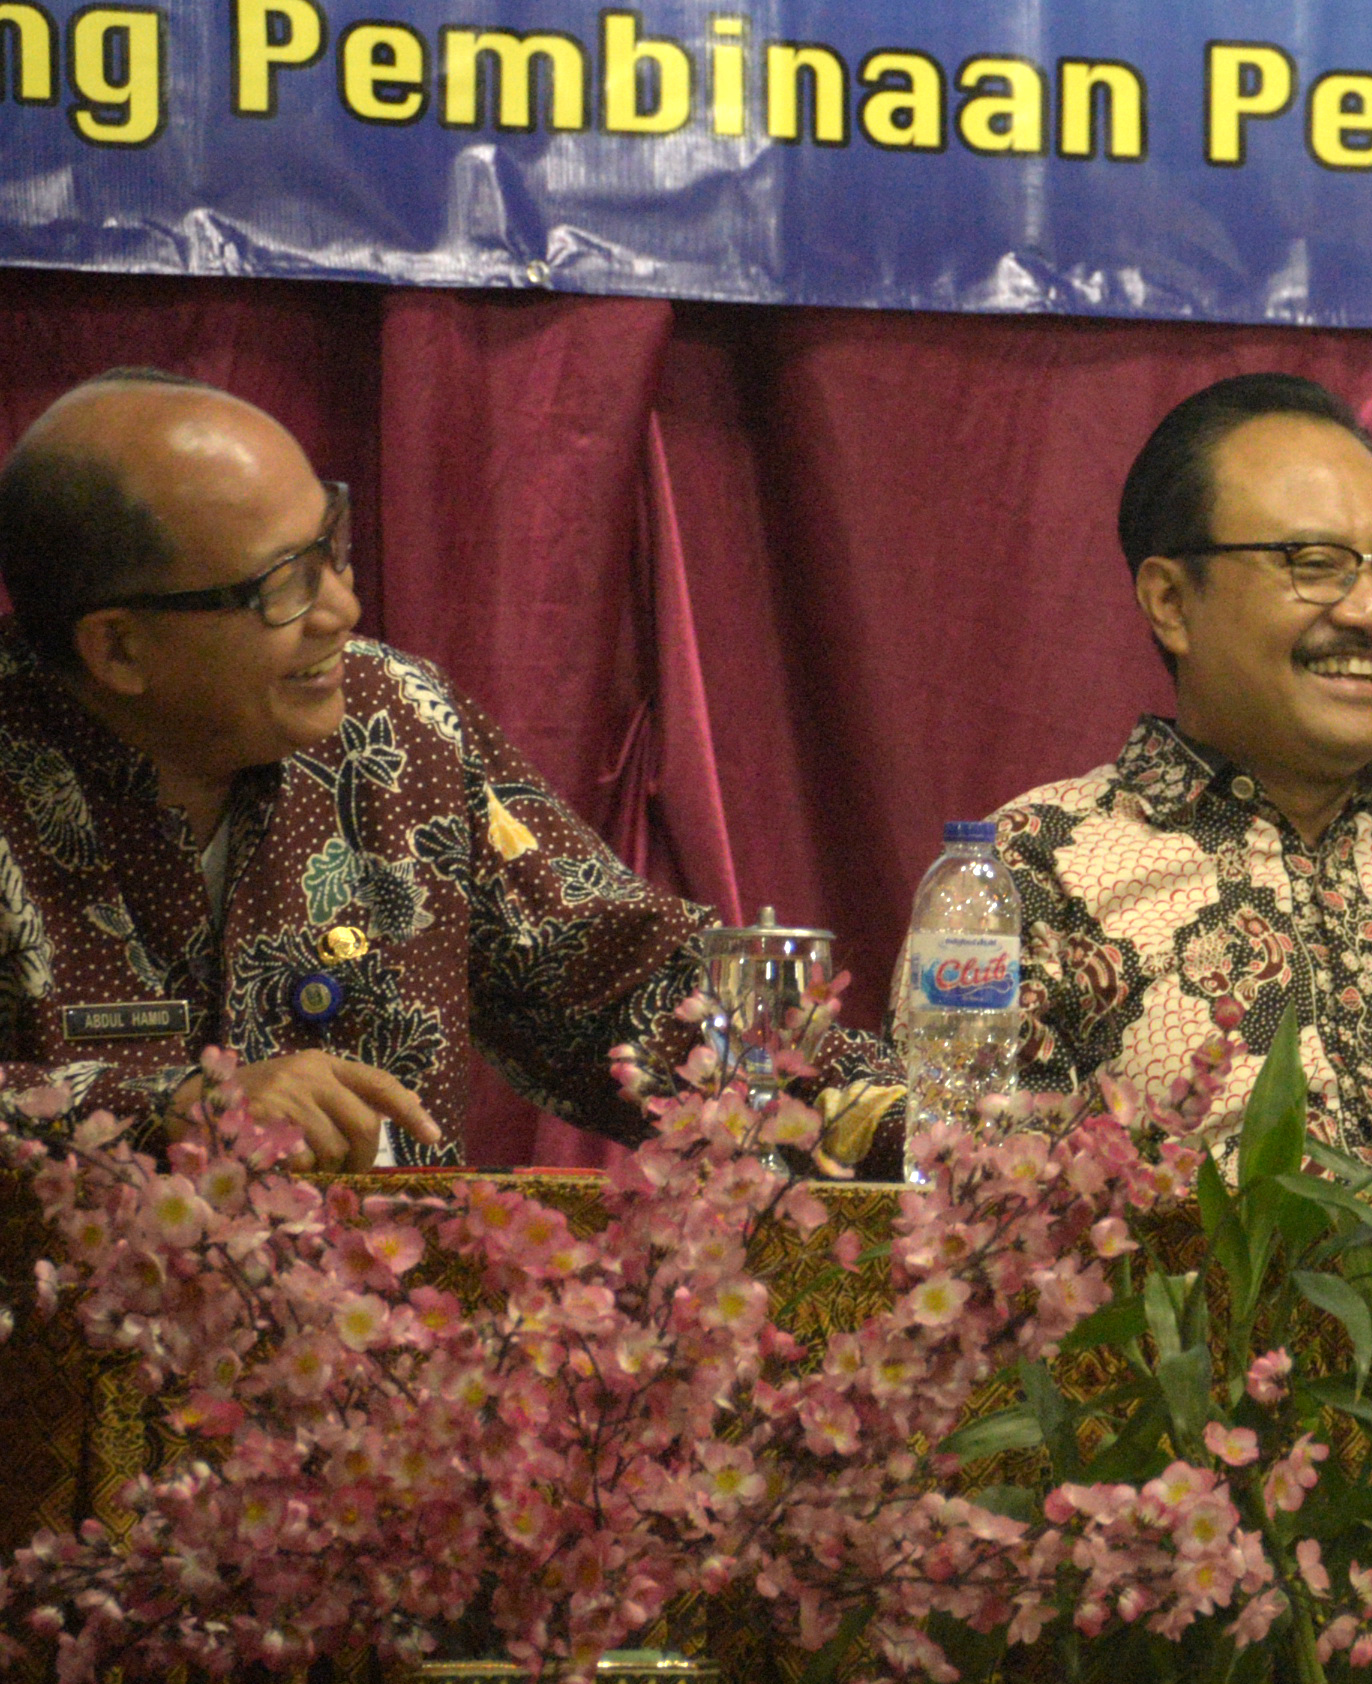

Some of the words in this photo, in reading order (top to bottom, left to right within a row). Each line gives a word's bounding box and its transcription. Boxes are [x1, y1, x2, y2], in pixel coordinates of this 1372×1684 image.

[232, 0, 1146, 162] Pembinaan
[935, 952, 1009, 990] Club
[84, 1013, 125, 1029] ABDUL
[131, 1010, 170, 1027] HAMID
